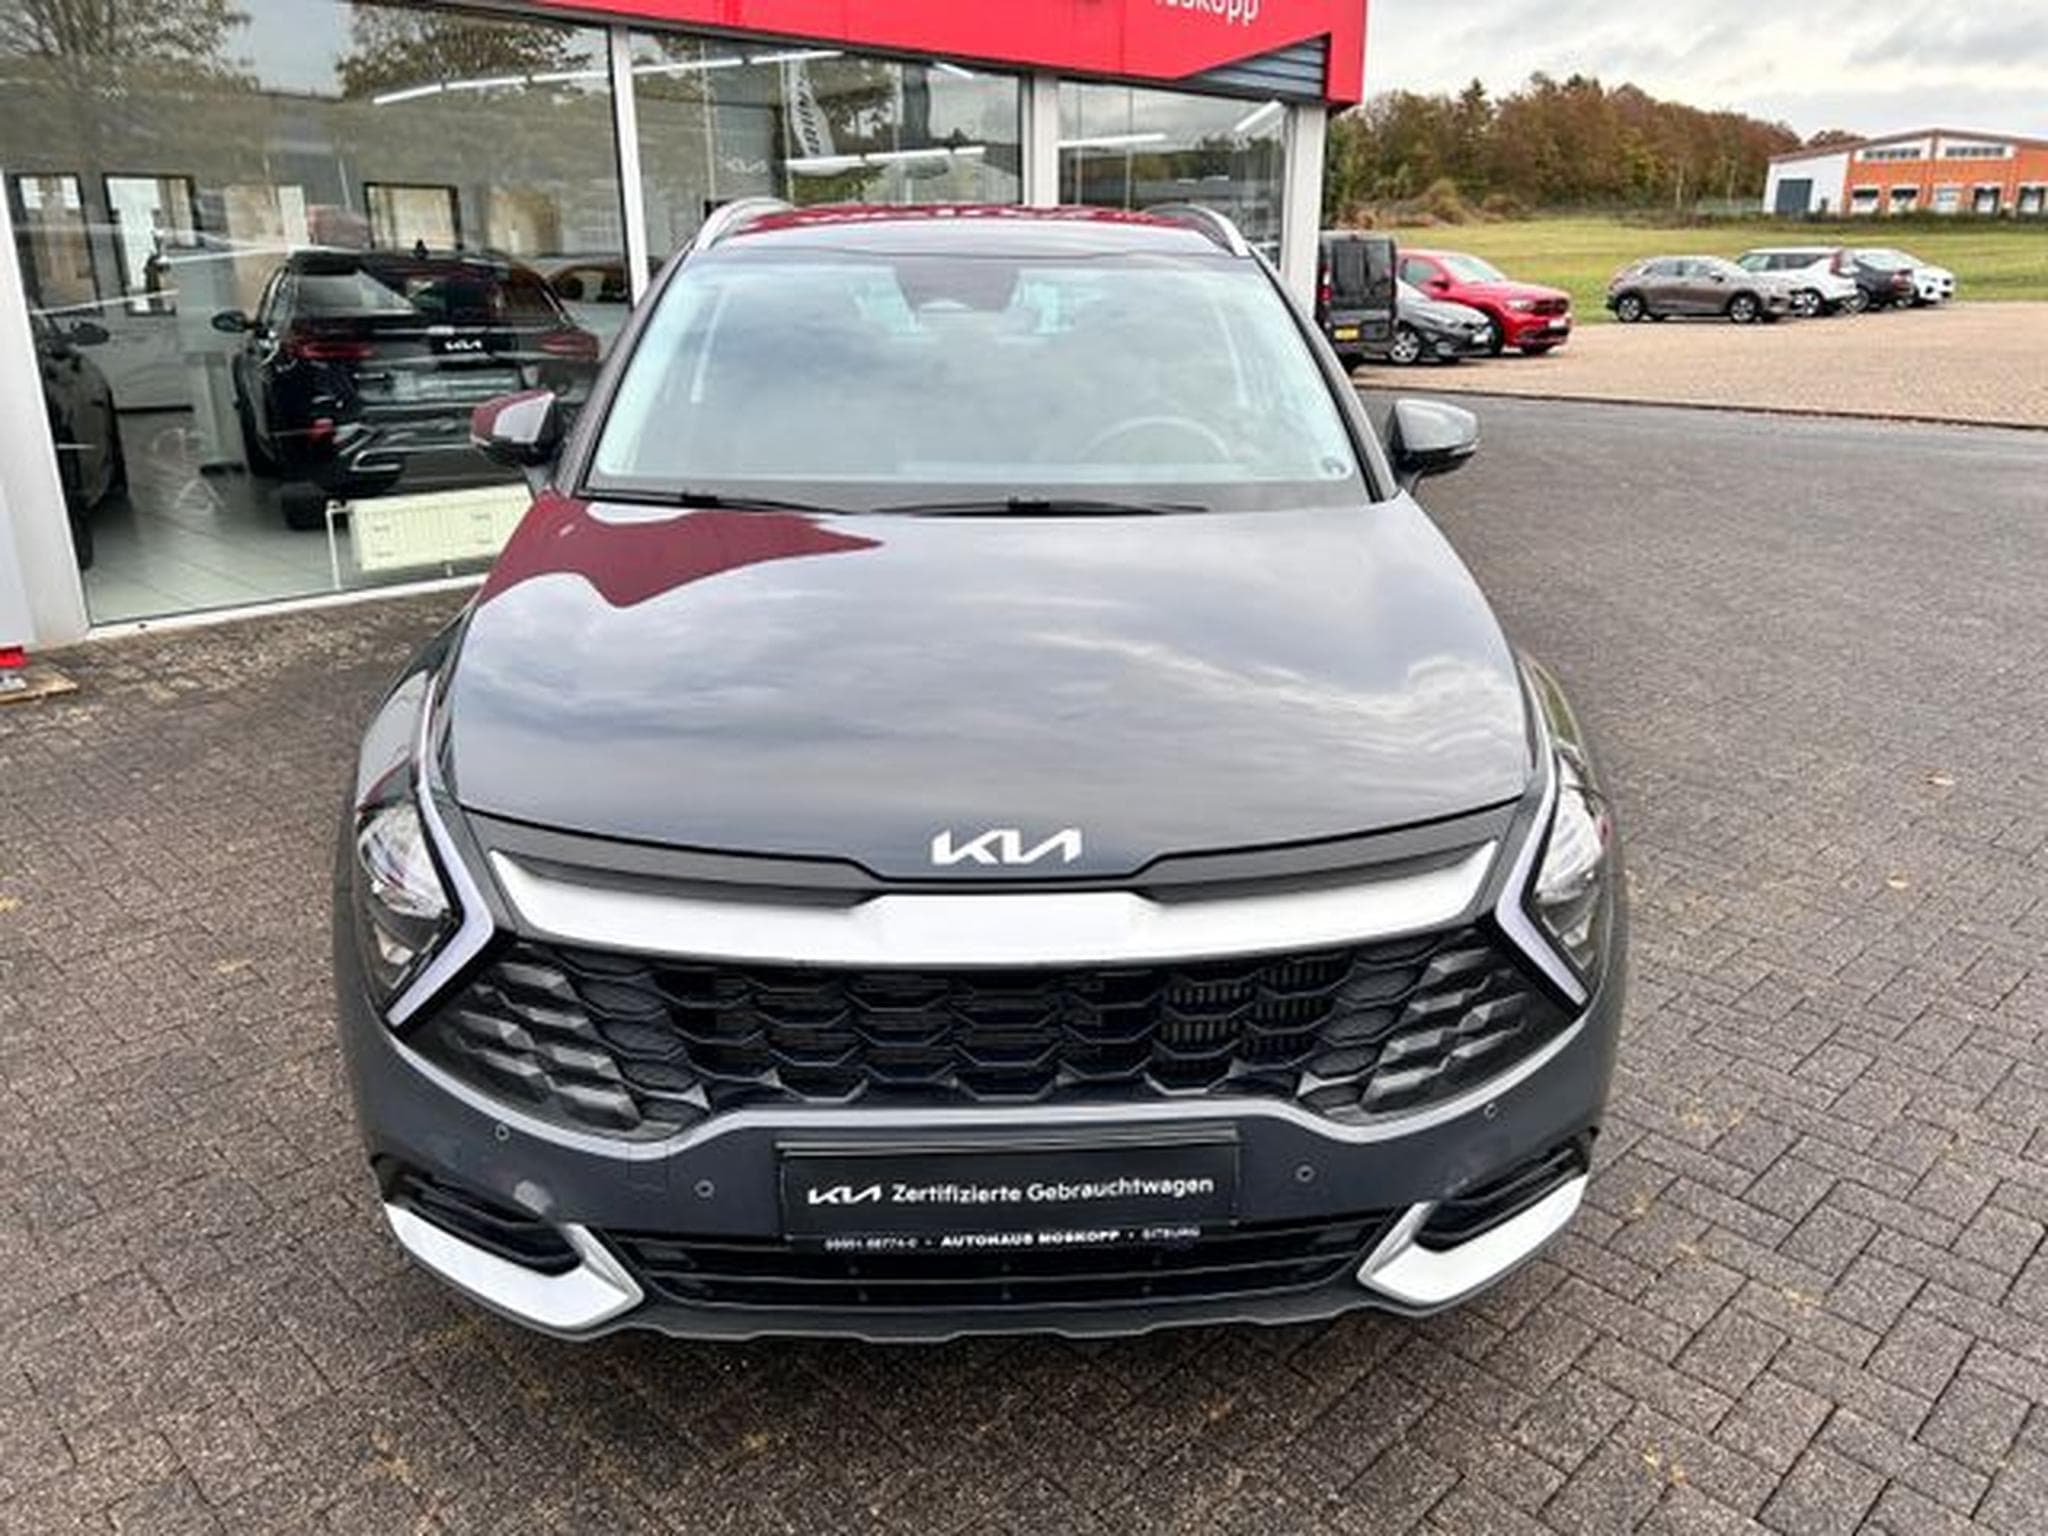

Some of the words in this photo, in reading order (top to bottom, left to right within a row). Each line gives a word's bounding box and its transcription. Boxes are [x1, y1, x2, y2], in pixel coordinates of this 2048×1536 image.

[931, 828, 1083, 865] KIA
[808, 1184, 881, 1204] KIA
[892, 1183, 1021, 1203] Zertifizierte
[1027, 1177, 1215, 1202] Gebrauchtwagen
[941, 1232, 1034, 1247] AUTOHAUS
[1038, 1228, 1120, 1244] MOSKOPP
